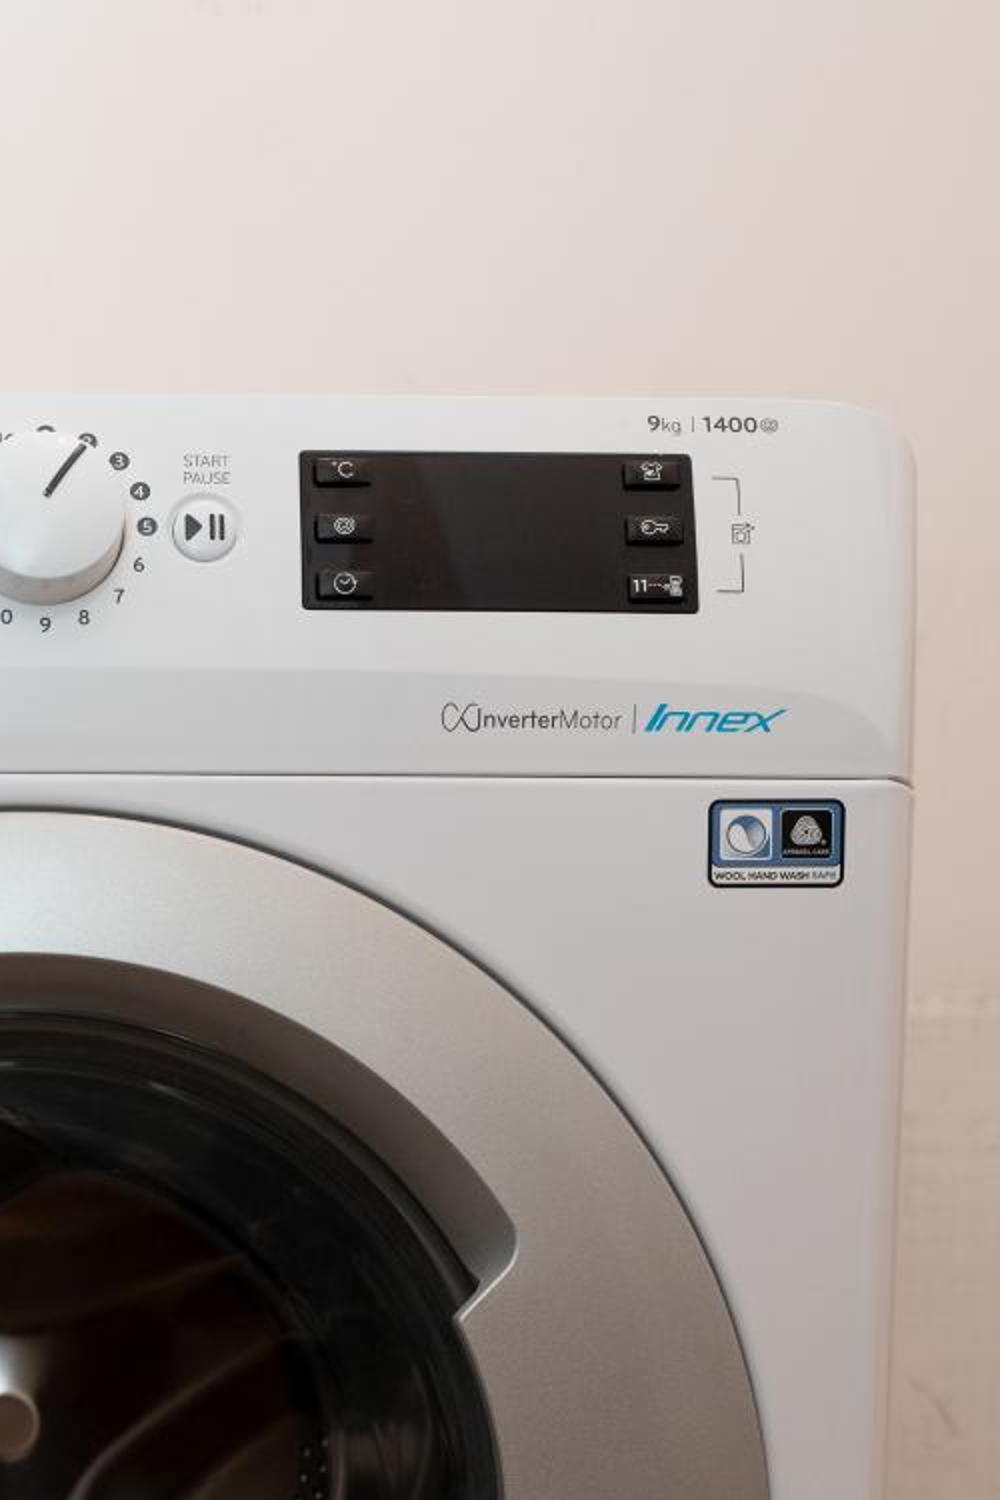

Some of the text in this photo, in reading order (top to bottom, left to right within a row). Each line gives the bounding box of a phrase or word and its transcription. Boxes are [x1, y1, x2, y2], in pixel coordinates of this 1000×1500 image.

[647, 415, 758, 436] 9kg 1400
[183, 454, 230, 468] START
[183, 471, 231, 485] PAUSE
[133, 557, 145, 573] 6
[632, 579, 648, 593] 11
[114, 589, 125, 604] 7
[39, 617, 51, 632] 9
[78, 609, 90, 625] 8
[644, 703, 790, 734] Innex
[713, 871, 747, 881] WOOL
[747, 871, 778, 881] HAND
[779, 871, 810, 881] WASH
